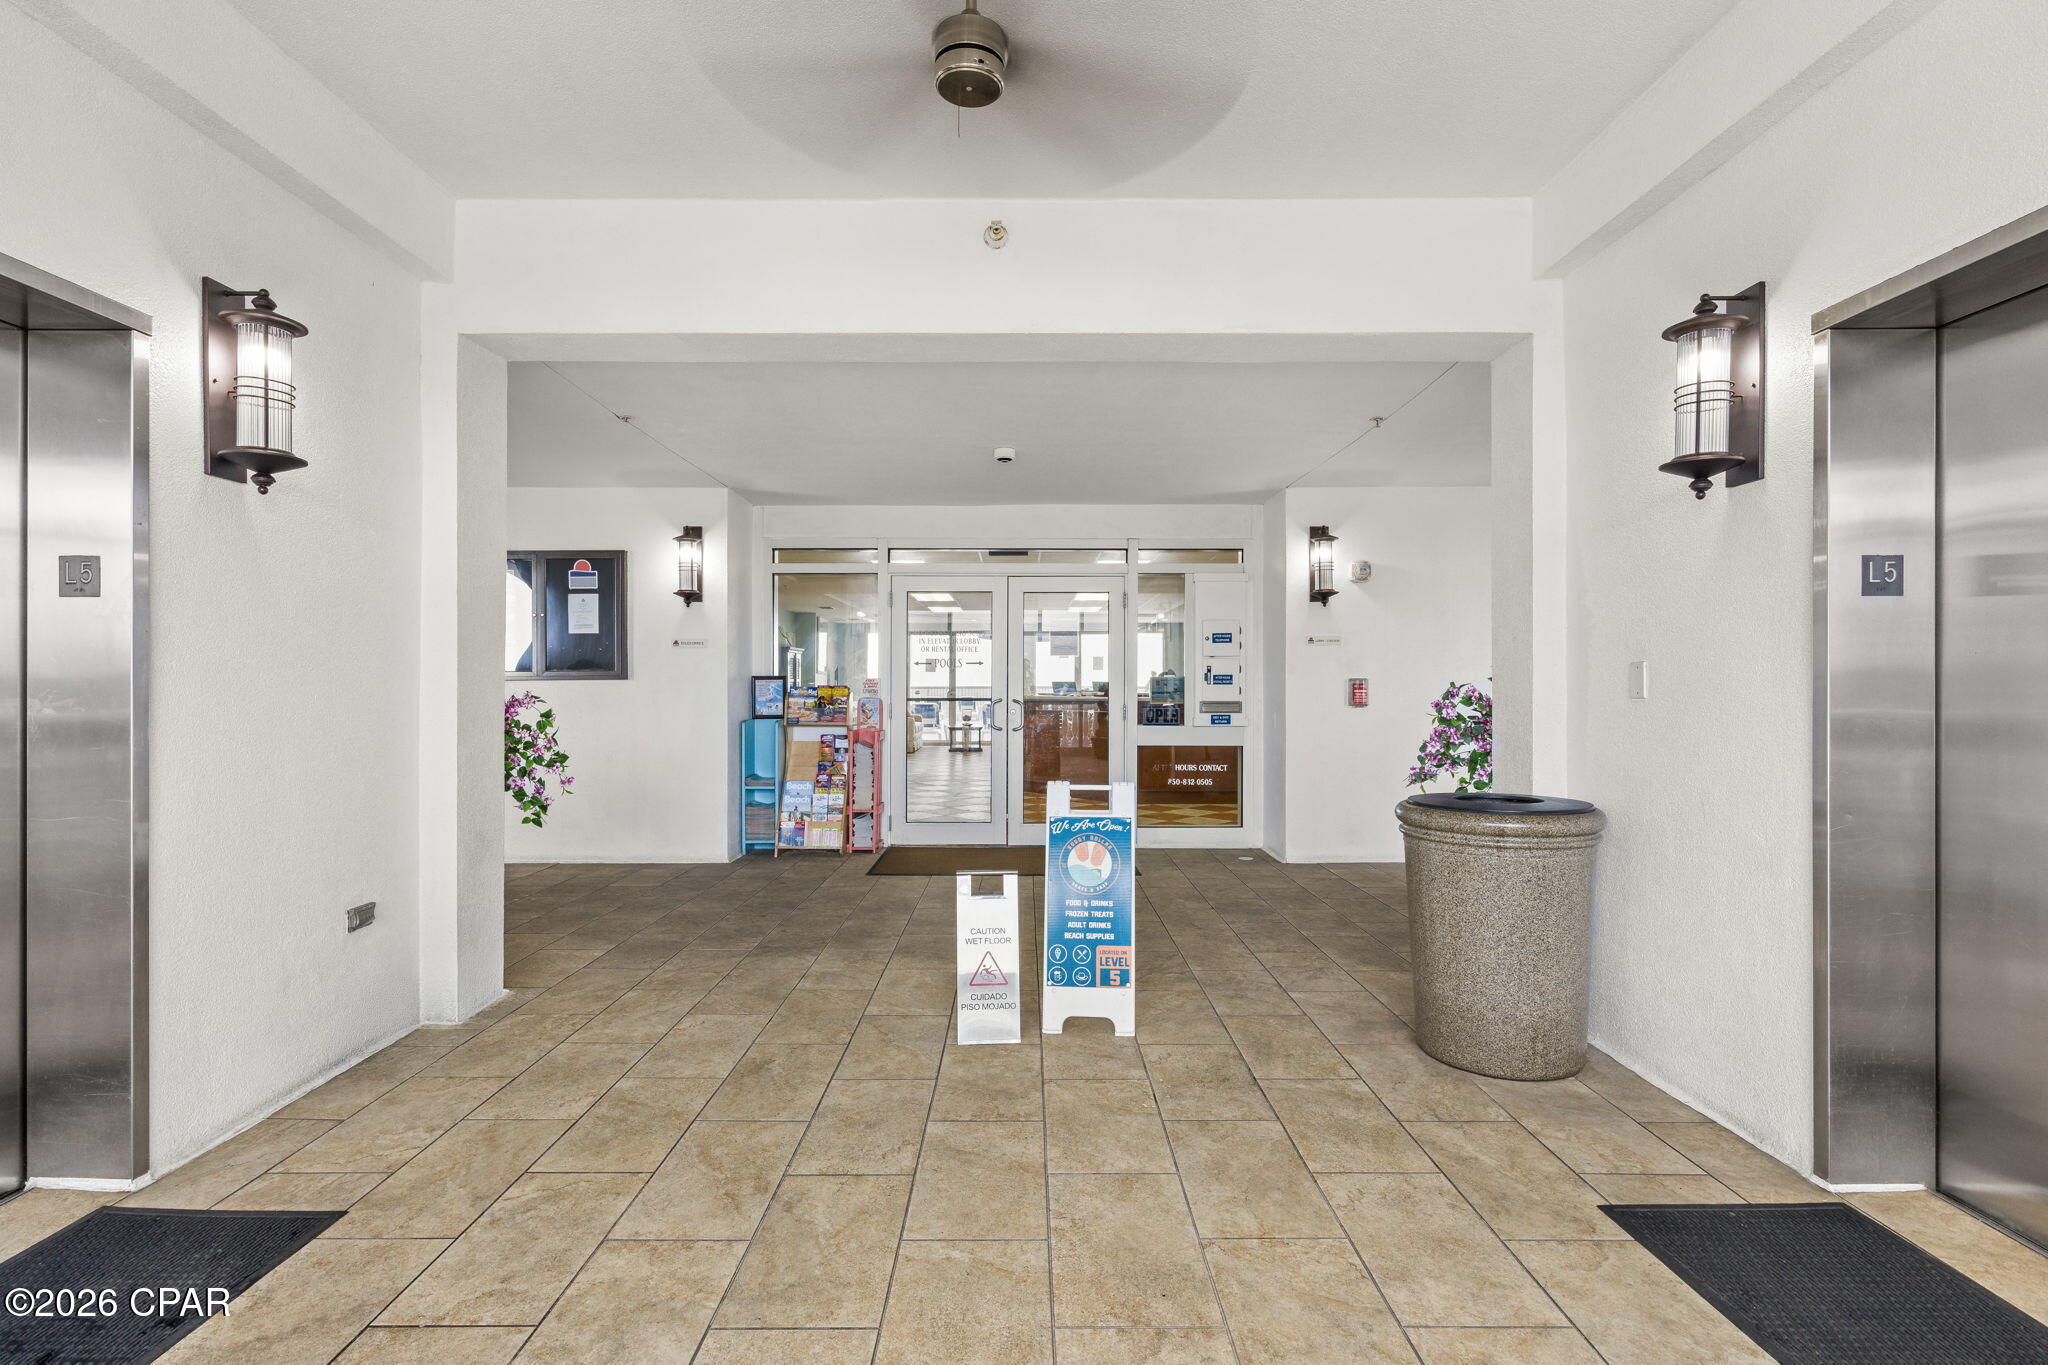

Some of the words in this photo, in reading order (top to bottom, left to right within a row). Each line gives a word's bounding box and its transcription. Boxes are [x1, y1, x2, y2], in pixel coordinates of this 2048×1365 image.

[65, 561, 93, 584] L5
[1869, 560, 1897, 583] L5
[1145, 708, 1179, 723] OPEN
[1175, 764, 1197, 772] HOURS
[1198, 764, 1228, 772] CONTACT
[786, 782, 812, 790] Beach
[1050, 820, 1070, 834] We
[1070, 819, 1096, 832] Are
[1065, 910, 1089, 918] FROZEN
[1067, 921, 1087, 929] ADULT
[1088, 921, 1111, 929] DRINKS
[970, 927, 1006, 935] CAUTION
[1086, 932, 1115, 940] SUPPLIES
[965, 937, 983, 945] WET
[1100, 956, 1130, 967] LEVEL
[1109, 970, 1121, 986] 5
[970, 993, 1008, 1001] CUIDADO
[960, 1003, 981, 1011] PISO
[981, 1002, 1017, 1010] MOJADO
